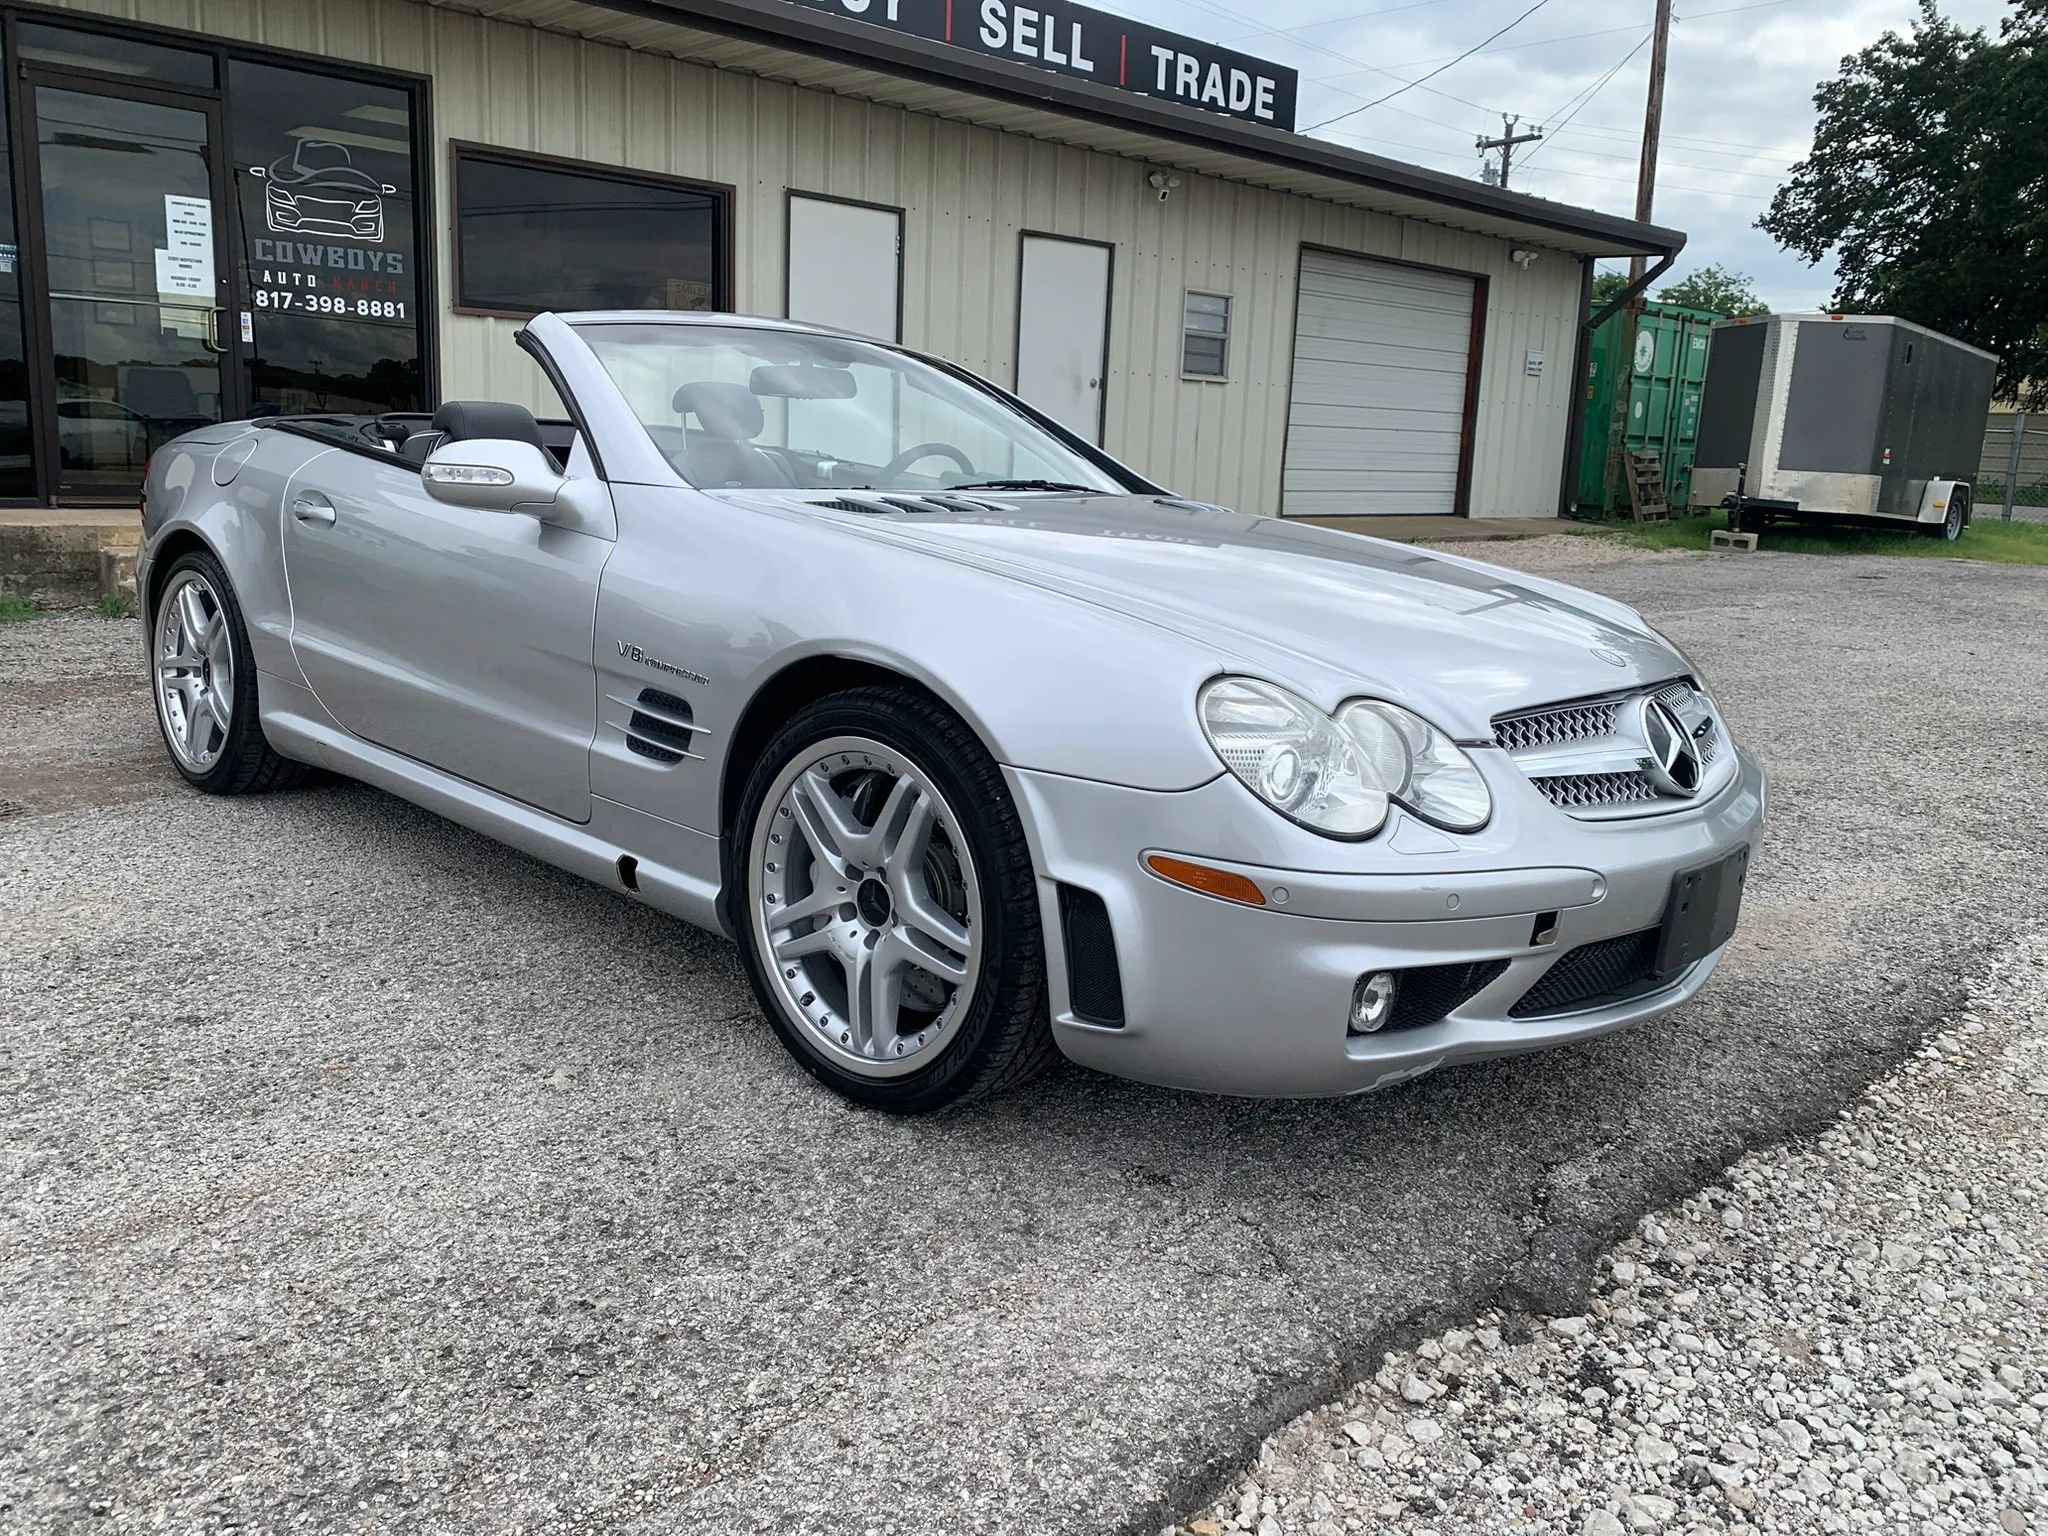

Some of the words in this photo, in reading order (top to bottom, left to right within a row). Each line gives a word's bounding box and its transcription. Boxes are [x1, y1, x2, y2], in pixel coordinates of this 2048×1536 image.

[980, 0, 1094, 72] SELL
[1151, 45, 1276, 120] TRADE
[254, 238, 404, 274] COWBOYS
[263, 269, 317, 287] AUTO
[255, 289, 405, 319] 817-398-8881
[617, 639, 644, 664] V8
